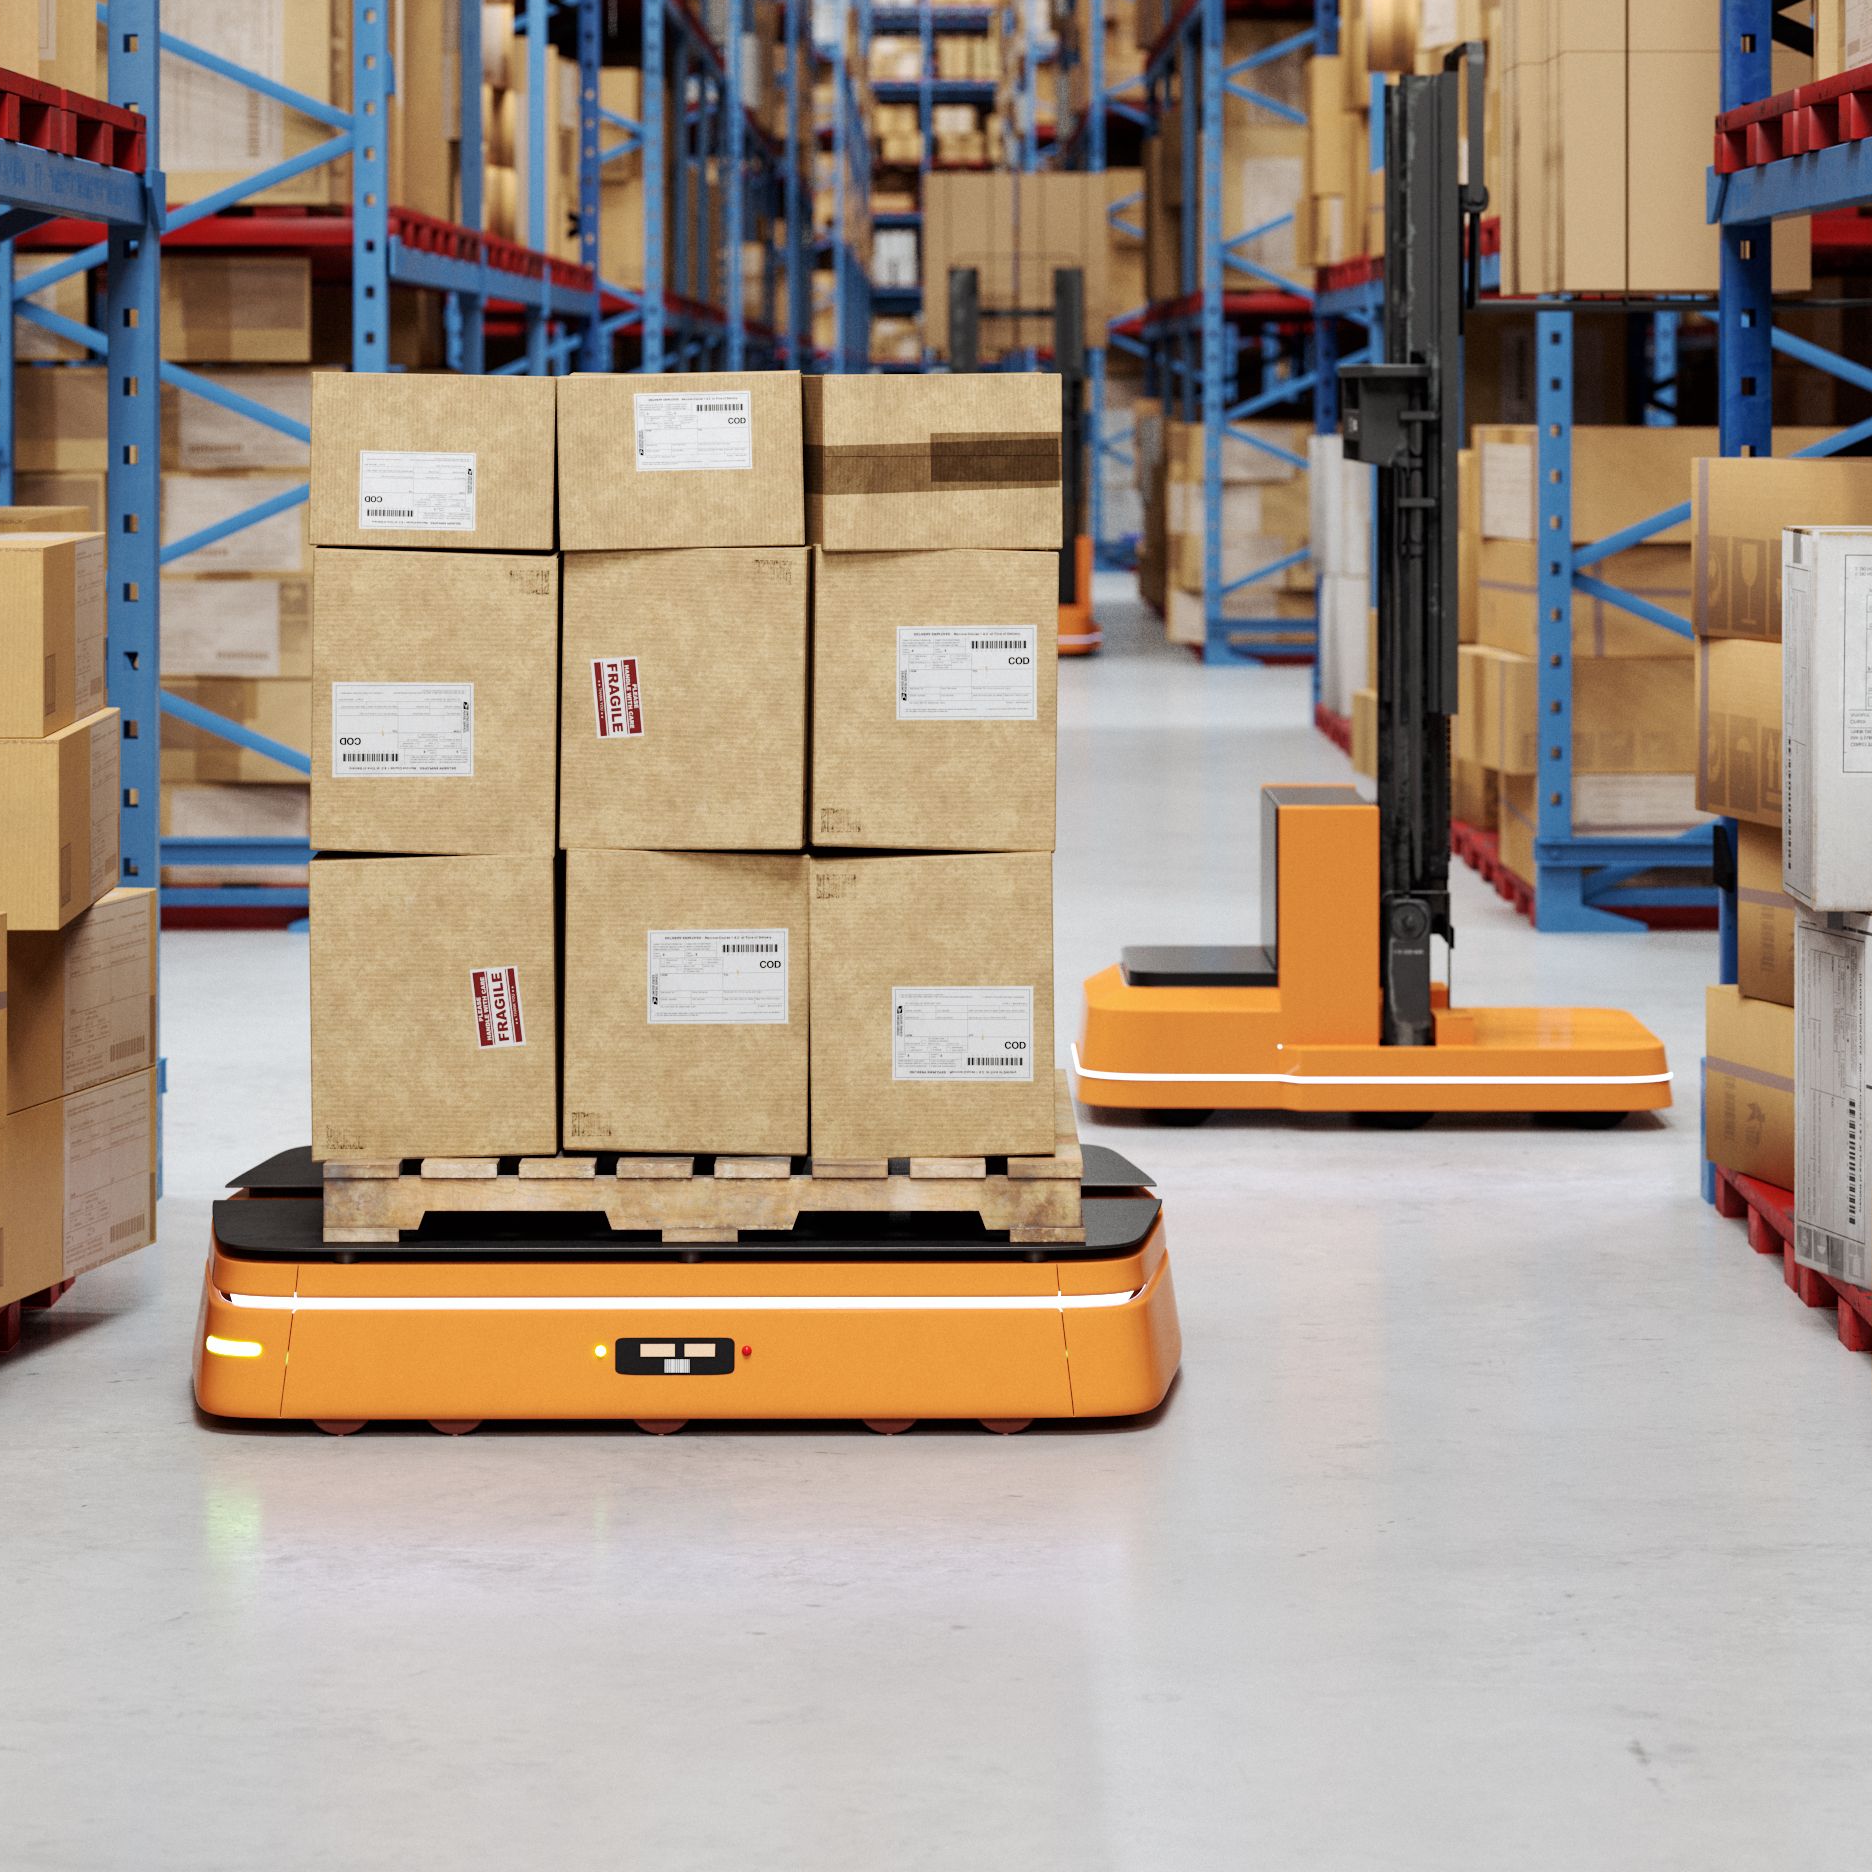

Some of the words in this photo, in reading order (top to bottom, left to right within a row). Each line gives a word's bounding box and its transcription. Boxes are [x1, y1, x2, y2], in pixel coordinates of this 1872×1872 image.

[1008, 657, 1030, 665] COD
[607, 664, 623, 732] FRAGILE
[340, 737, 361, 745] COD
[491, 972, 509, 1041] FRAGILE
